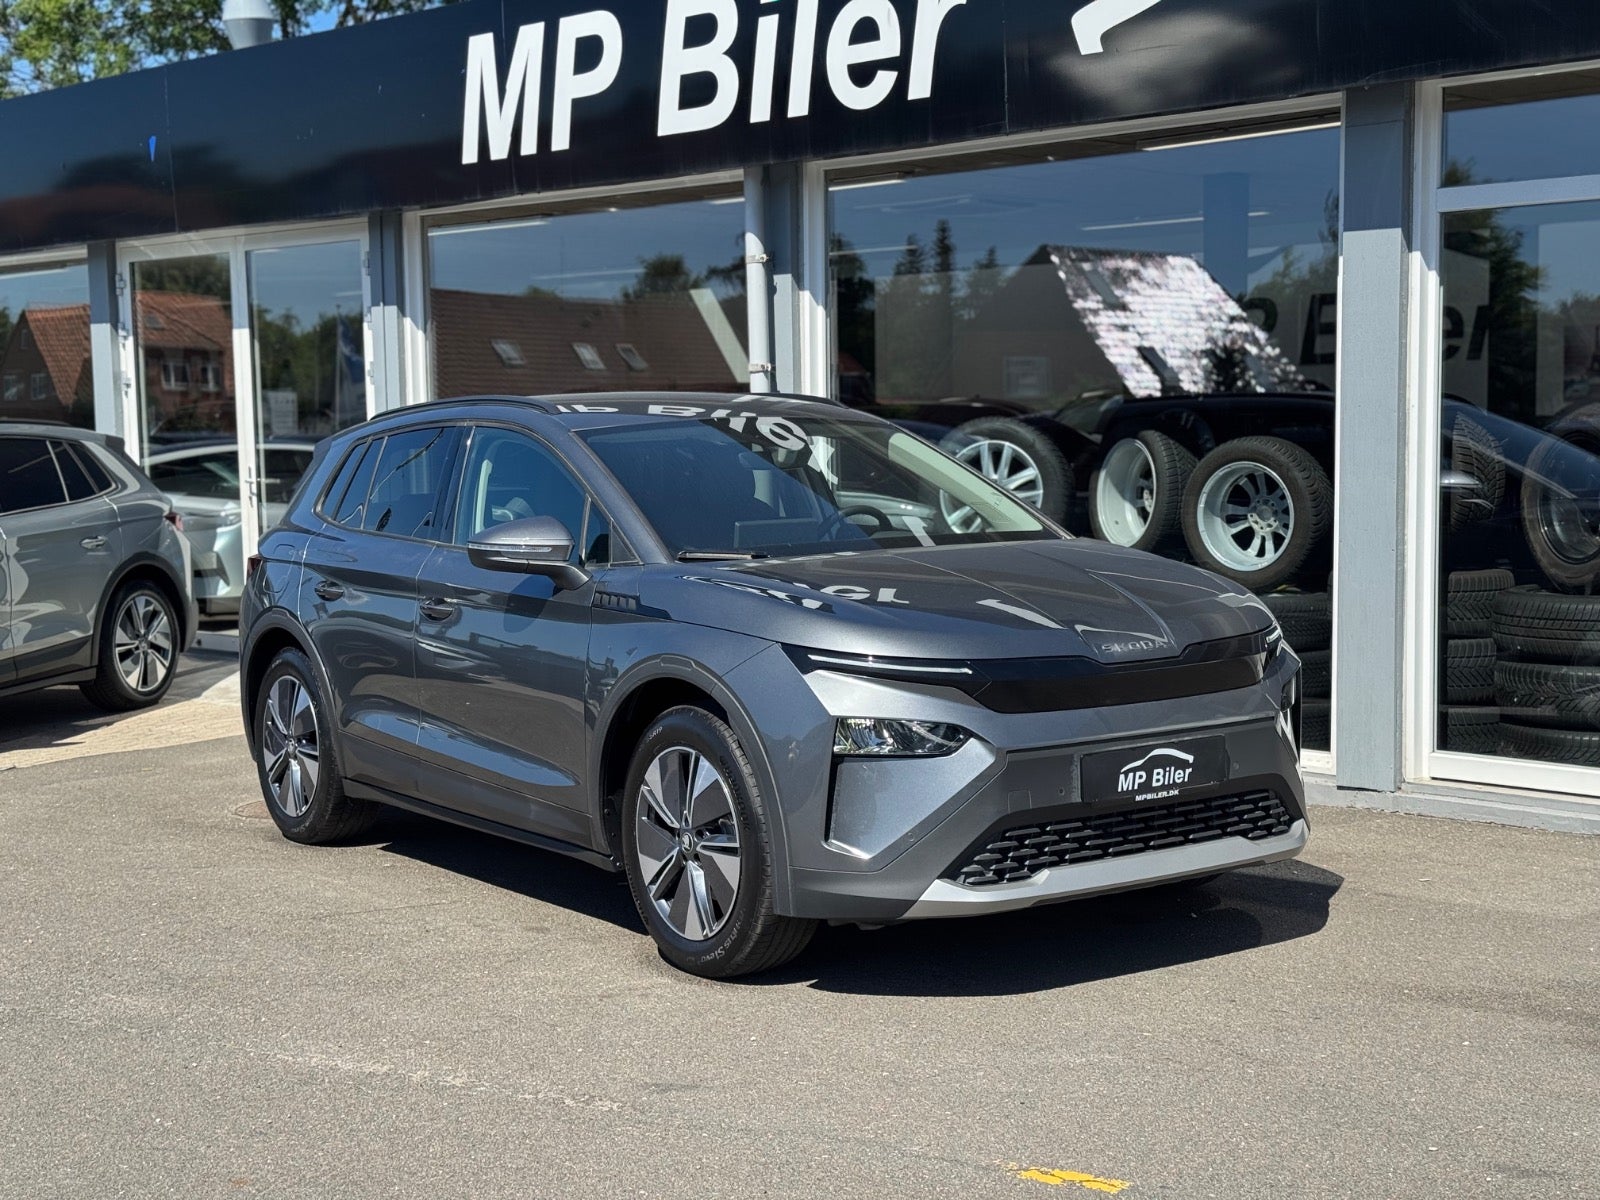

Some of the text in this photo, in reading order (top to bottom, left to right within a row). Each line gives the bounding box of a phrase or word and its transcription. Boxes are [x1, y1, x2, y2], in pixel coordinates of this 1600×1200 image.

[461, 0, 966, 165] MP Biler
[1117, 766, 1192, 793] MP Biler
[1135, 788, 1180, 802] MPBILER.DK
